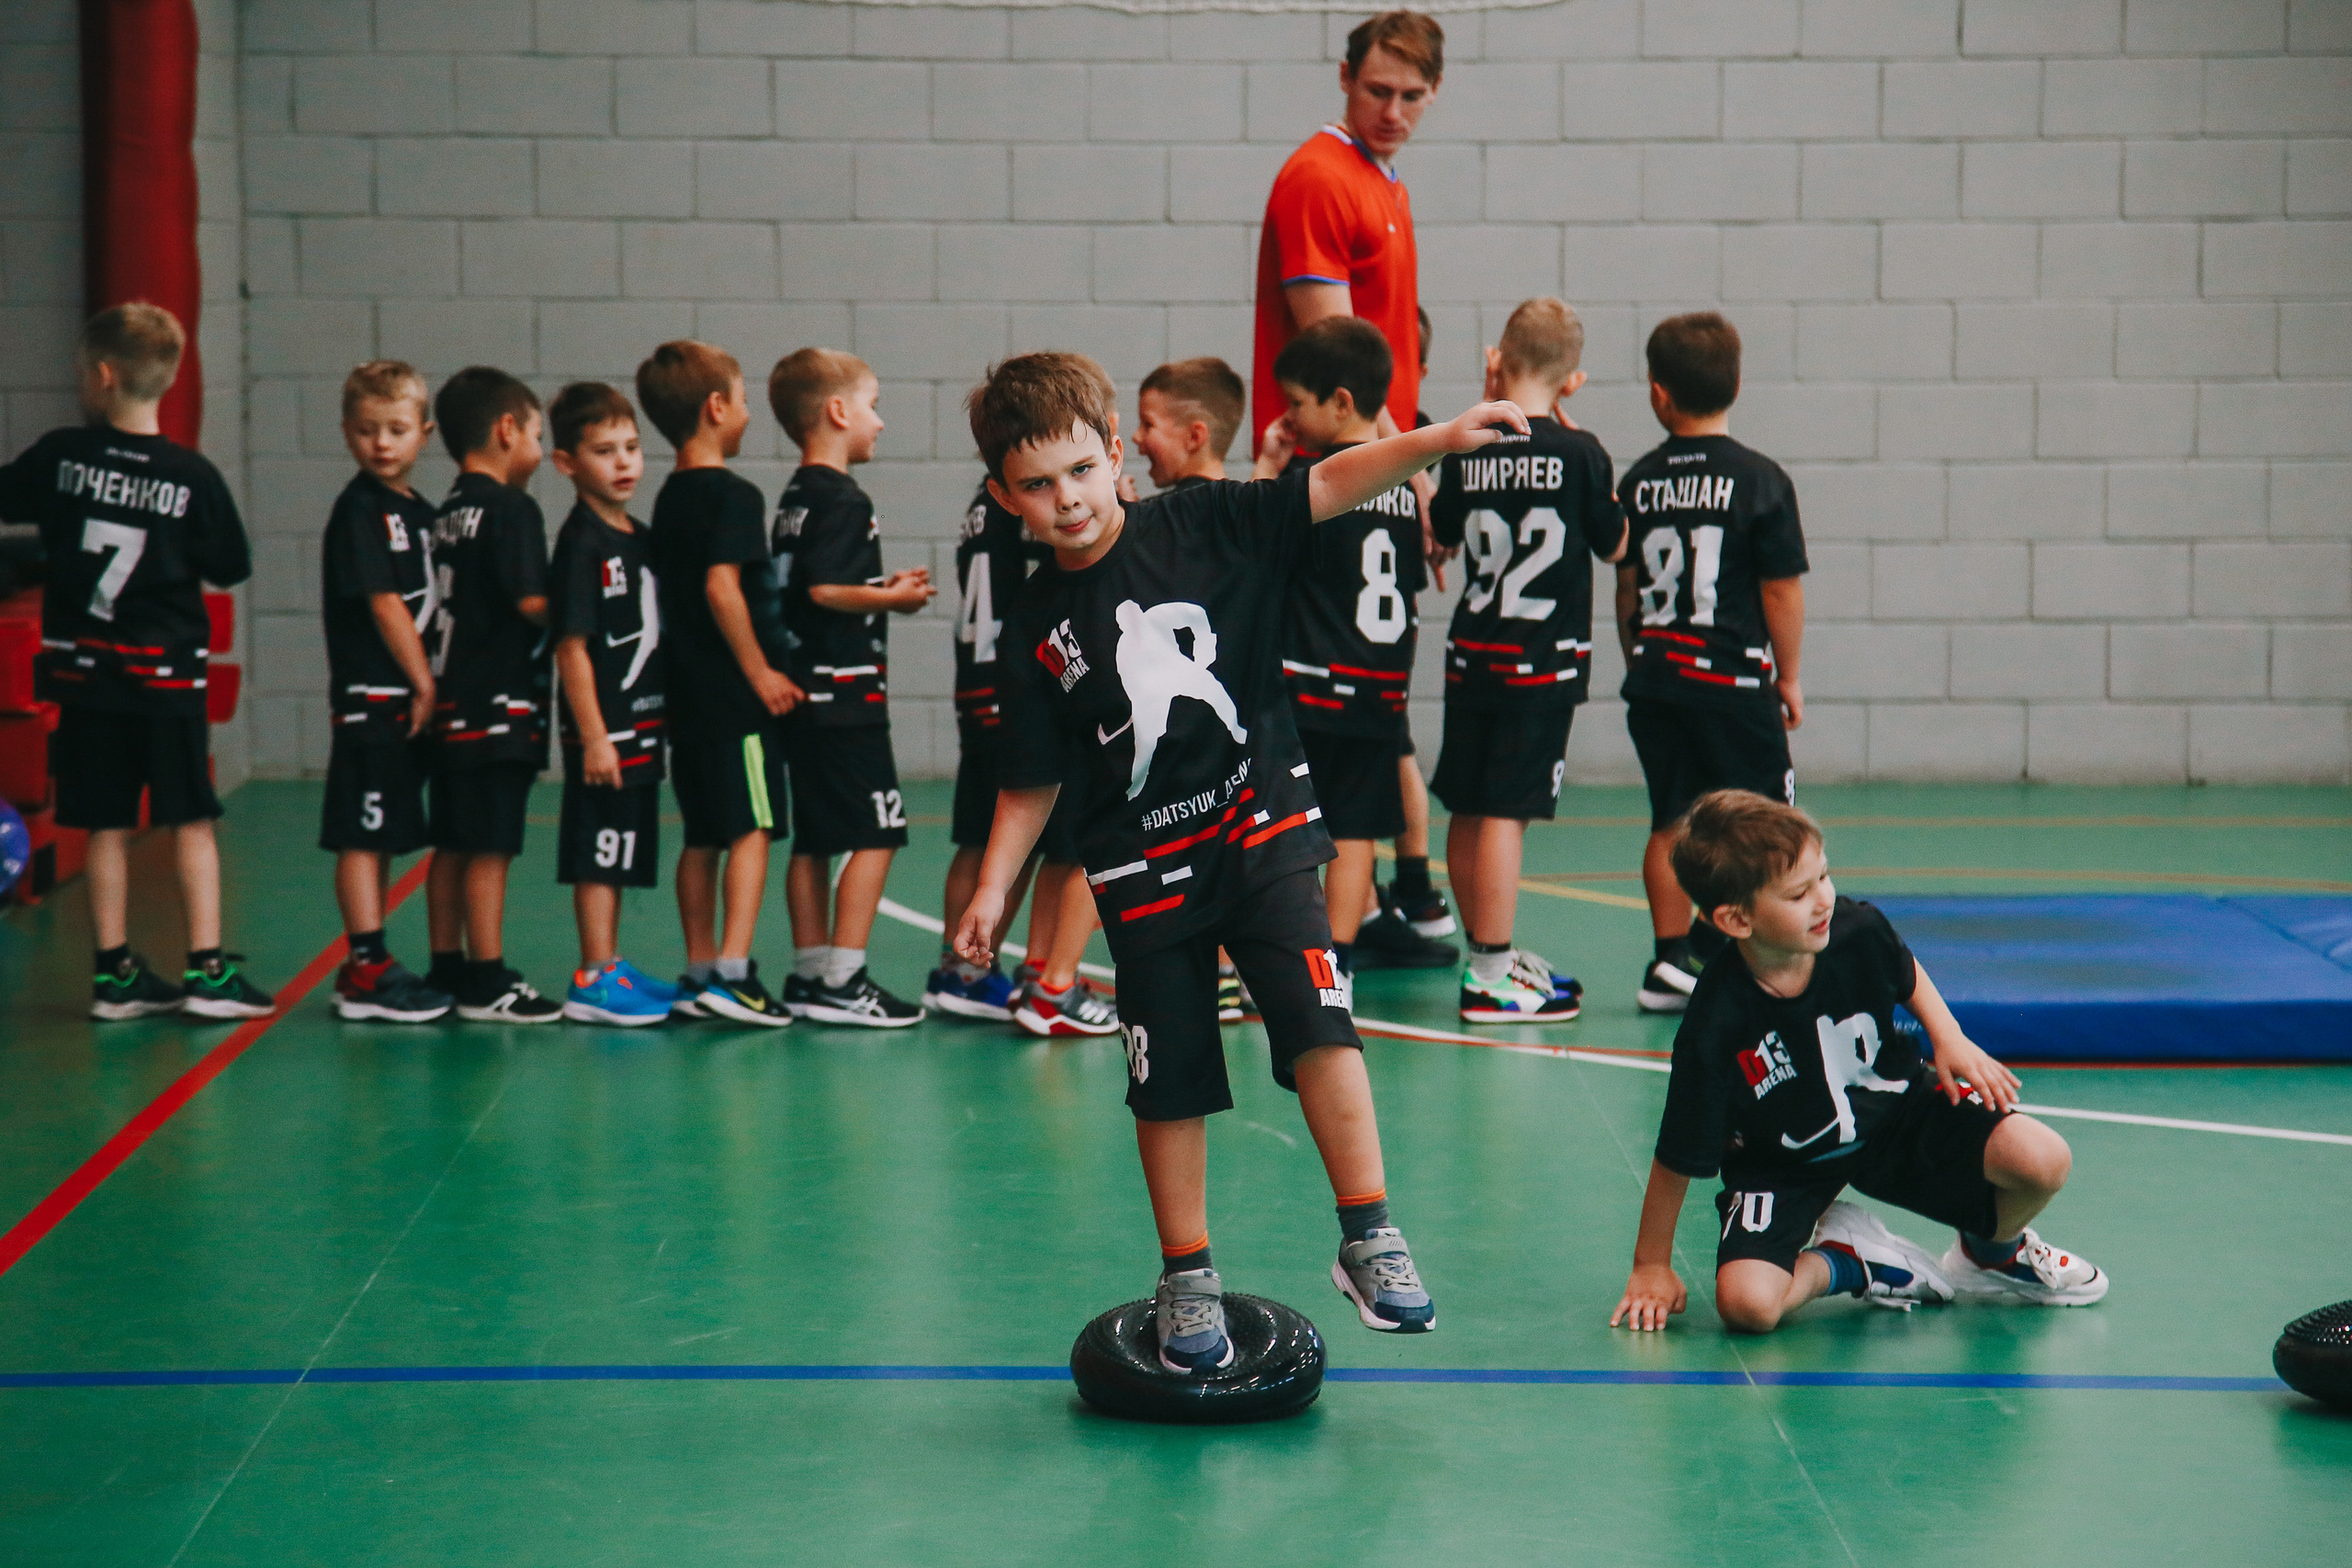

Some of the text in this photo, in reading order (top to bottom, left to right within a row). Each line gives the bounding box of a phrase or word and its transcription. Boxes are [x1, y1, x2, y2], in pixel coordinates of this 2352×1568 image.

[1462, 456, 1564, 492] ШИРЯЕВ
[1634, 474, 1735, 513] СТАШАН
[80, 518, 148, 622] 7
[1464, 507, 1566, 621] 92
[1639, 525, 1724, 626] 81
[1355, 527, 1408, 644] 8
[1035, 618, 1082, 678] D13
[1059, 656, 1091, 694] ARENA
[361, 791, 384, 831] 5
[872, 789, 906, 828] 12
[595, 828, 637, 870] 91
[1736, 1030, 1792, 1087] D13
[1754, 1064, 1798, 1100] ARENA
